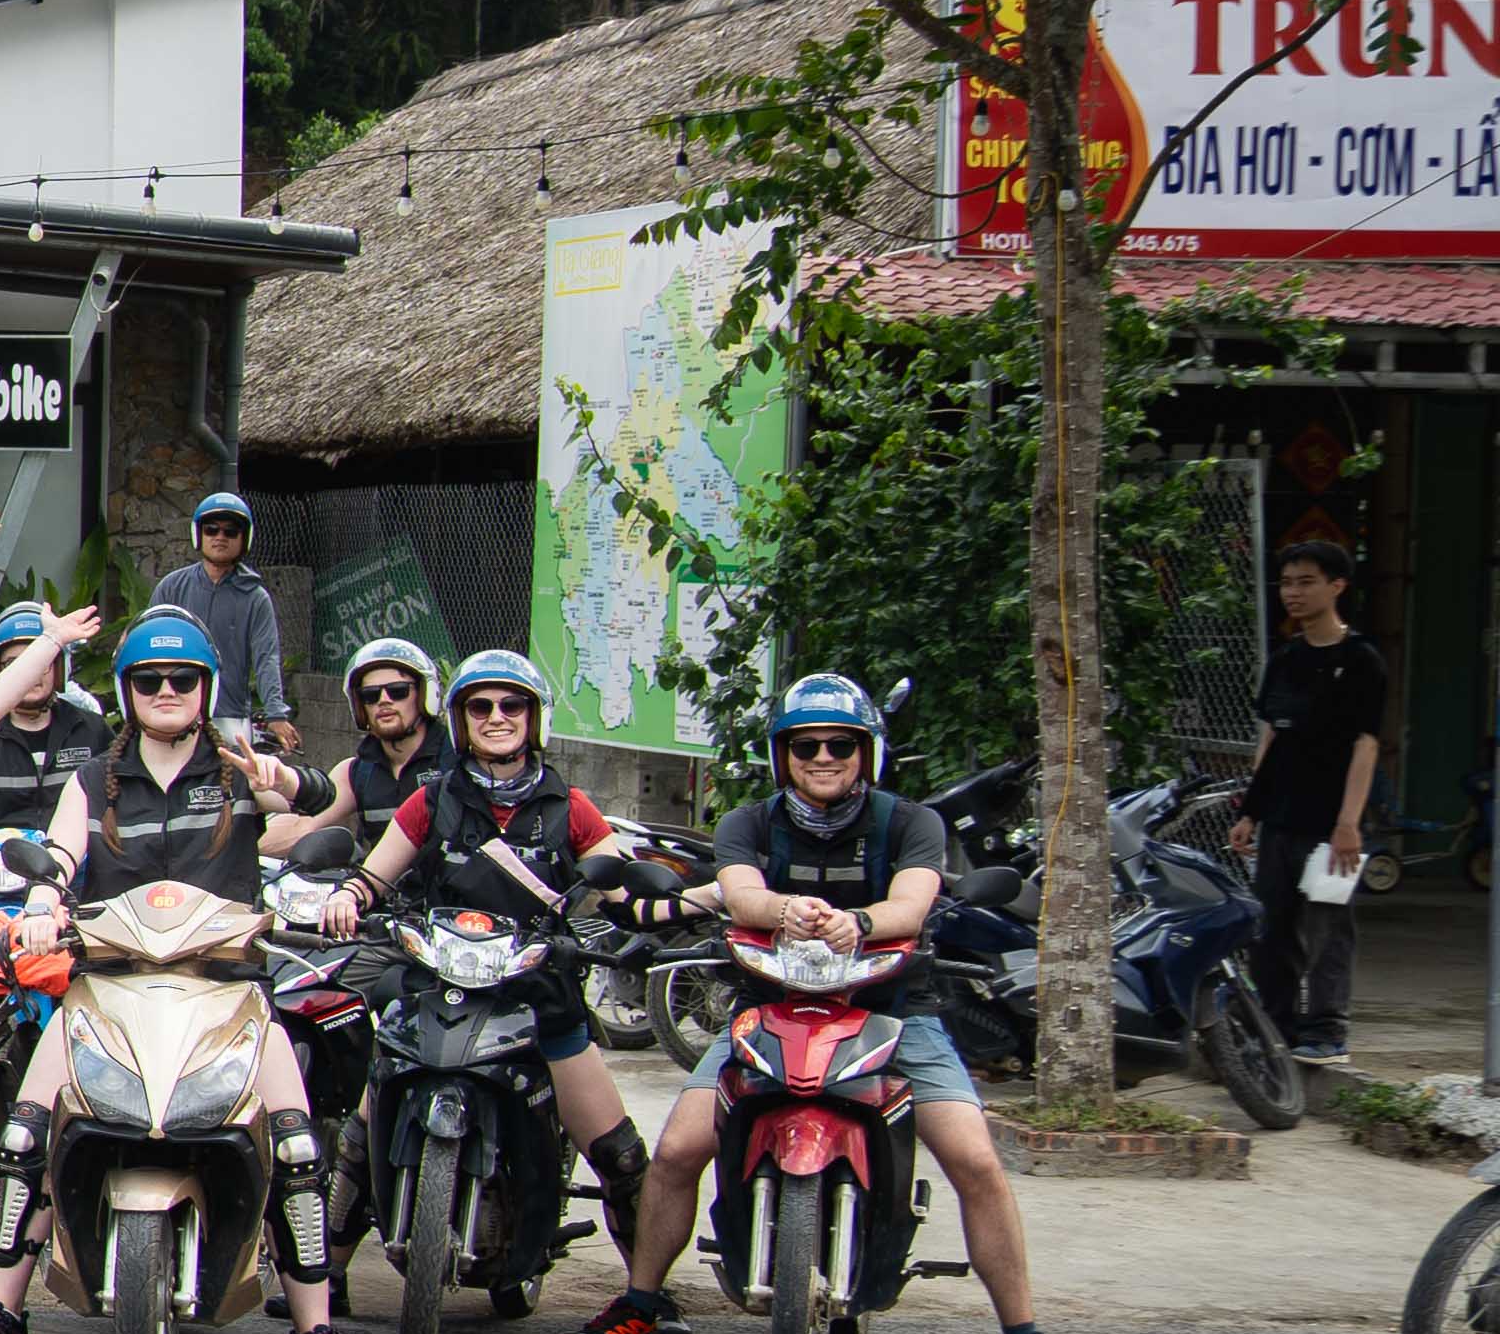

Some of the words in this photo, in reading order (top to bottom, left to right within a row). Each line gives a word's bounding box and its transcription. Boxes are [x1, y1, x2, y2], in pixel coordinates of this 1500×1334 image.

[966, 134, 1028, 168] CHÍN
[1162, 126, 1222, 195] BIA
[981, 233, 1032, 251] HOTL
[322, 1012, 362, 1031] HONDA
